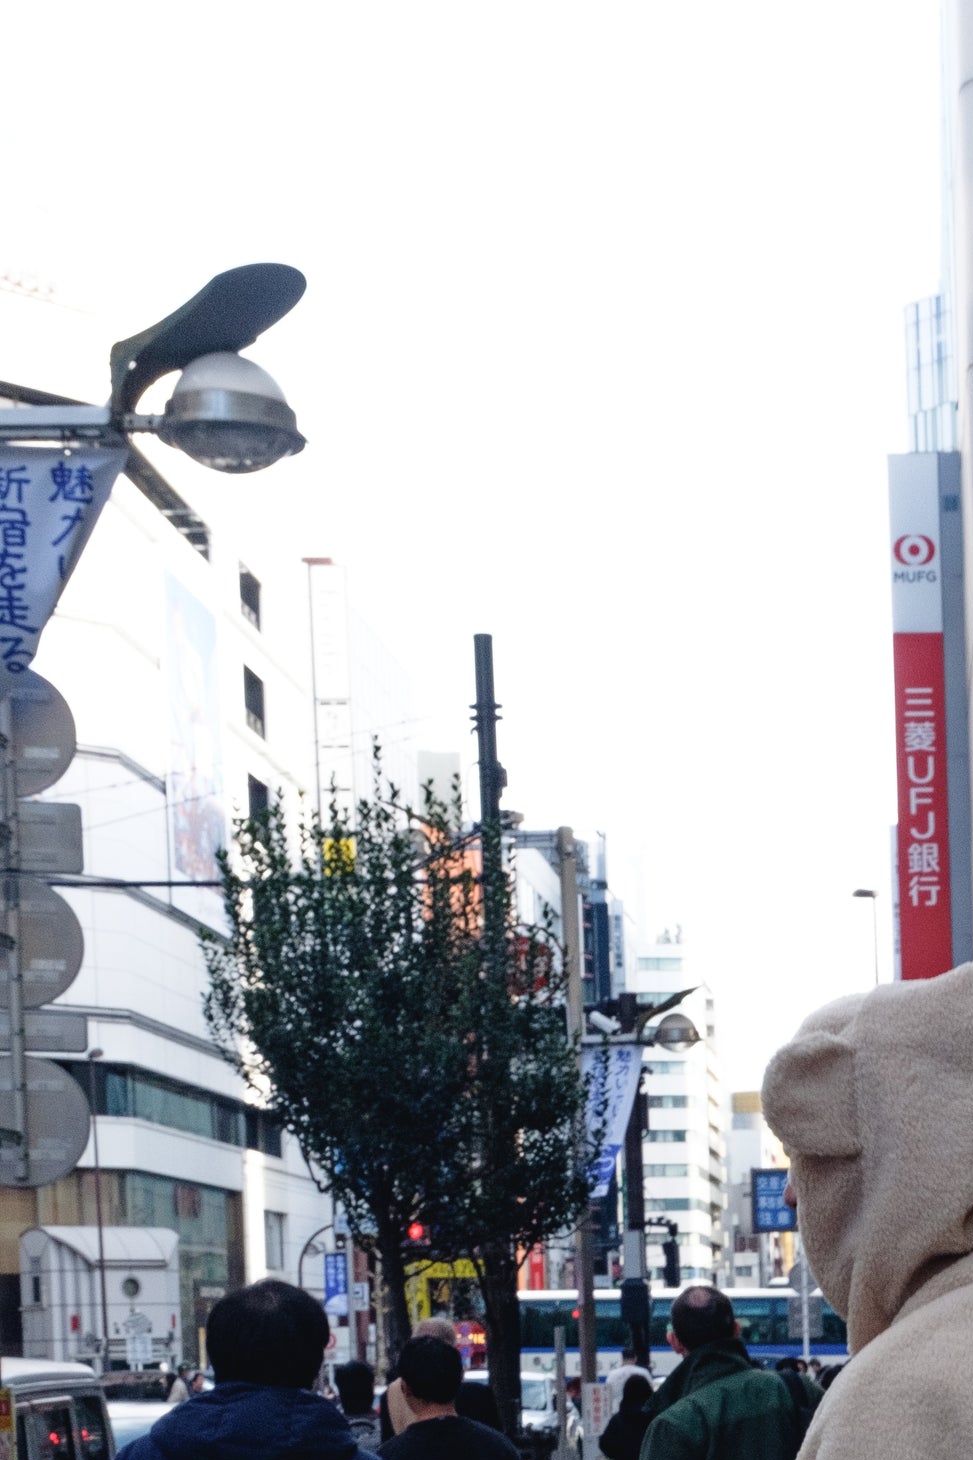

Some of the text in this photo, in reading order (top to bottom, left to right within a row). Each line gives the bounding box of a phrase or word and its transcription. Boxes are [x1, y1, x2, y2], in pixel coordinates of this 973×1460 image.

[893, 570, 937, 583] MUFG
[904, 687, 941, 907] 三菱UFJ銀行
